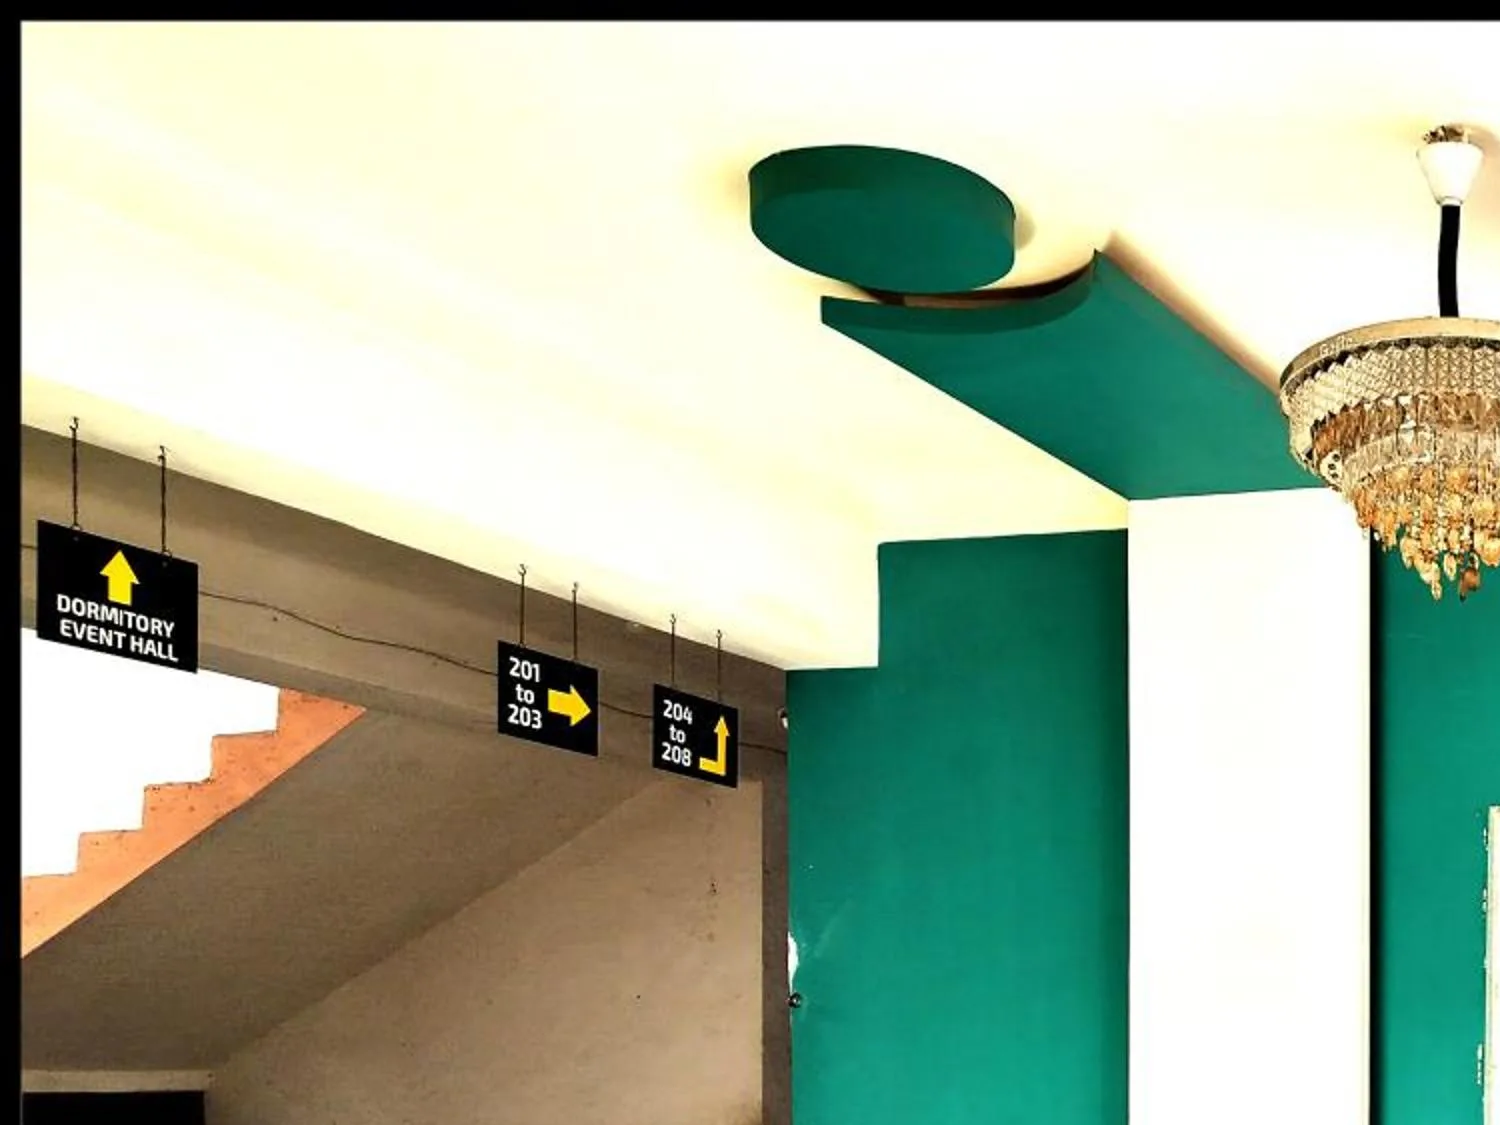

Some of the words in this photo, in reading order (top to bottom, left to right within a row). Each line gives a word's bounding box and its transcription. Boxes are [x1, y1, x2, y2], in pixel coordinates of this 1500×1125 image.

[56, 593, 175, 638] DORMITORY
[60, 618, 127, 649] EVENT
[130, 635, 179, 662] HALL
[509, 656, 541, 683] 201
[515, 683, 535, 705] to
[507, 703, 543, 729] 203
[662, 700, 693, 725] 204
[669, 723, 686, 743] to
[661, 742, 692, 767] 208
